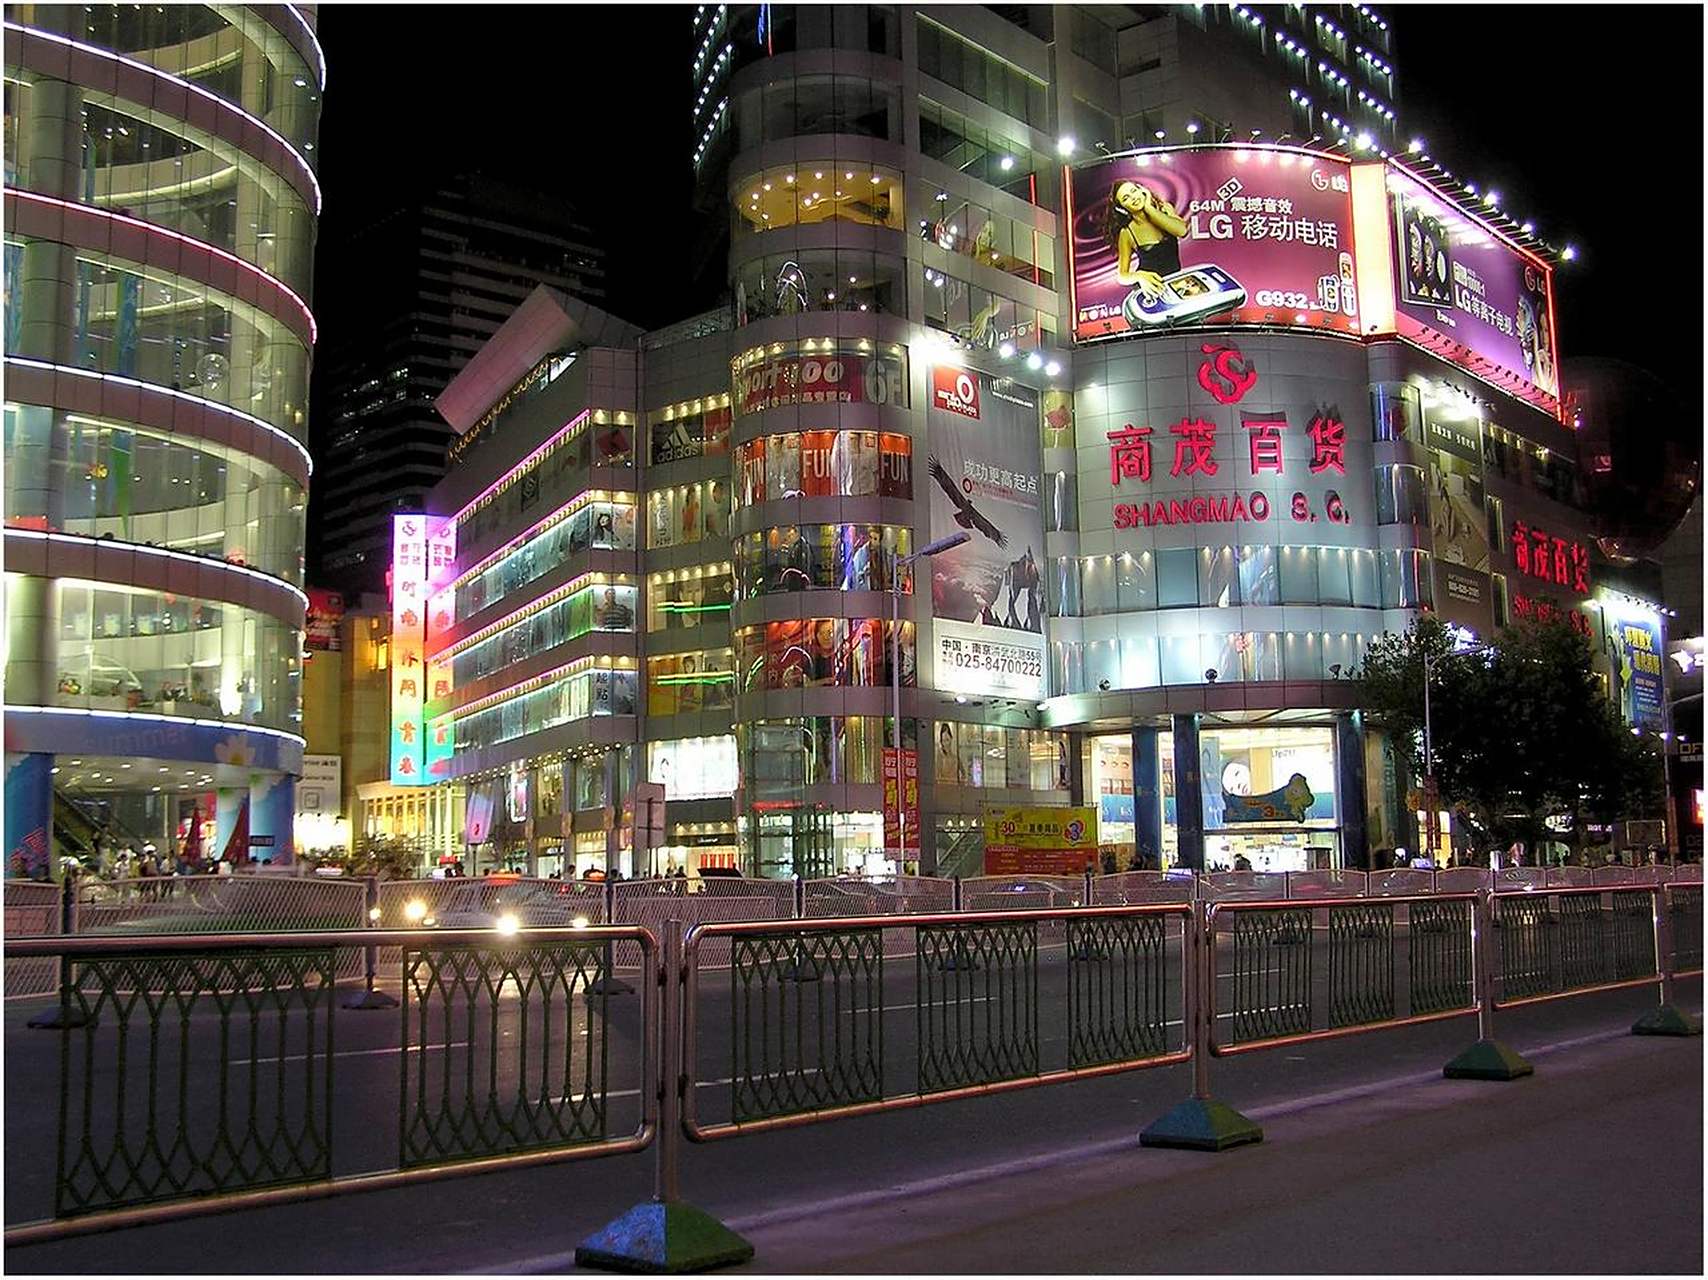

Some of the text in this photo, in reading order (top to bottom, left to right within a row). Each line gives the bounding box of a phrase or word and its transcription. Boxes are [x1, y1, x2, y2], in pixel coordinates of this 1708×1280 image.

[1219, 180, 1240, 200] 3D
[1189, 200, 1226, 213] 64M
[1190, 213, 1339, 250] LG 移动电话
[1455, 284, 1472, 314] LG
[1106, 408, 1347, 487] 商茂百货
[880, 450, 909, 482] FUN
[963, 458, 1039, 496] 成功更高起点
[1113, 490, 1271, 530] SHANGMAO
[956, 652, 1042, 678] 025-84700222
